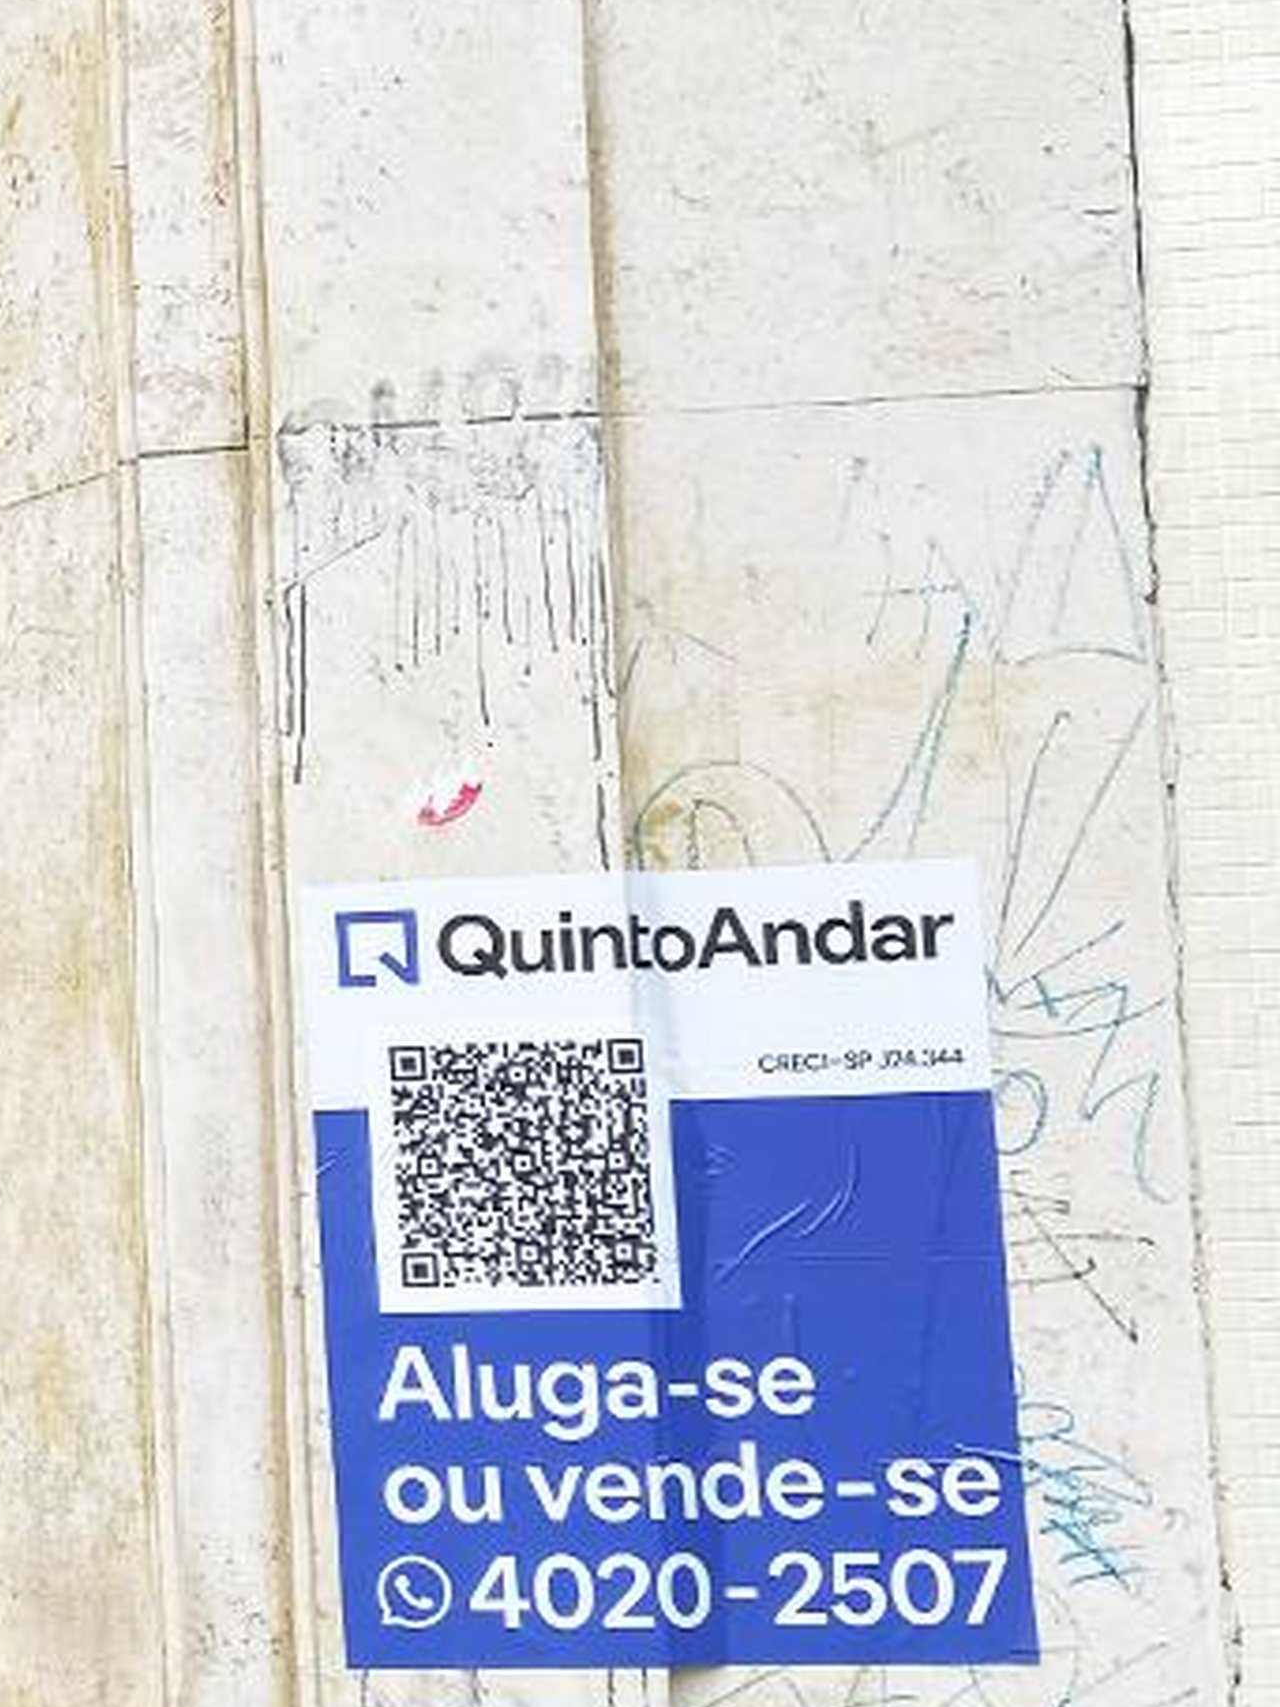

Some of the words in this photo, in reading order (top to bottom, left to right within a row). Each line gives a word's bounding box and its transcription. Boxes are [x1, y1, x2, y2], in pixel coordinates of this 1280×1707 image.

[437, 900, 954, 981] QuintoAndar
[378, 1344, 816, 1441] Aluga-se
[383, 1466, 503, 1524] ou
[525, 1441, 1001, 1524] vende-se
[469, 1548, 1008, 1630] 4020-2507
